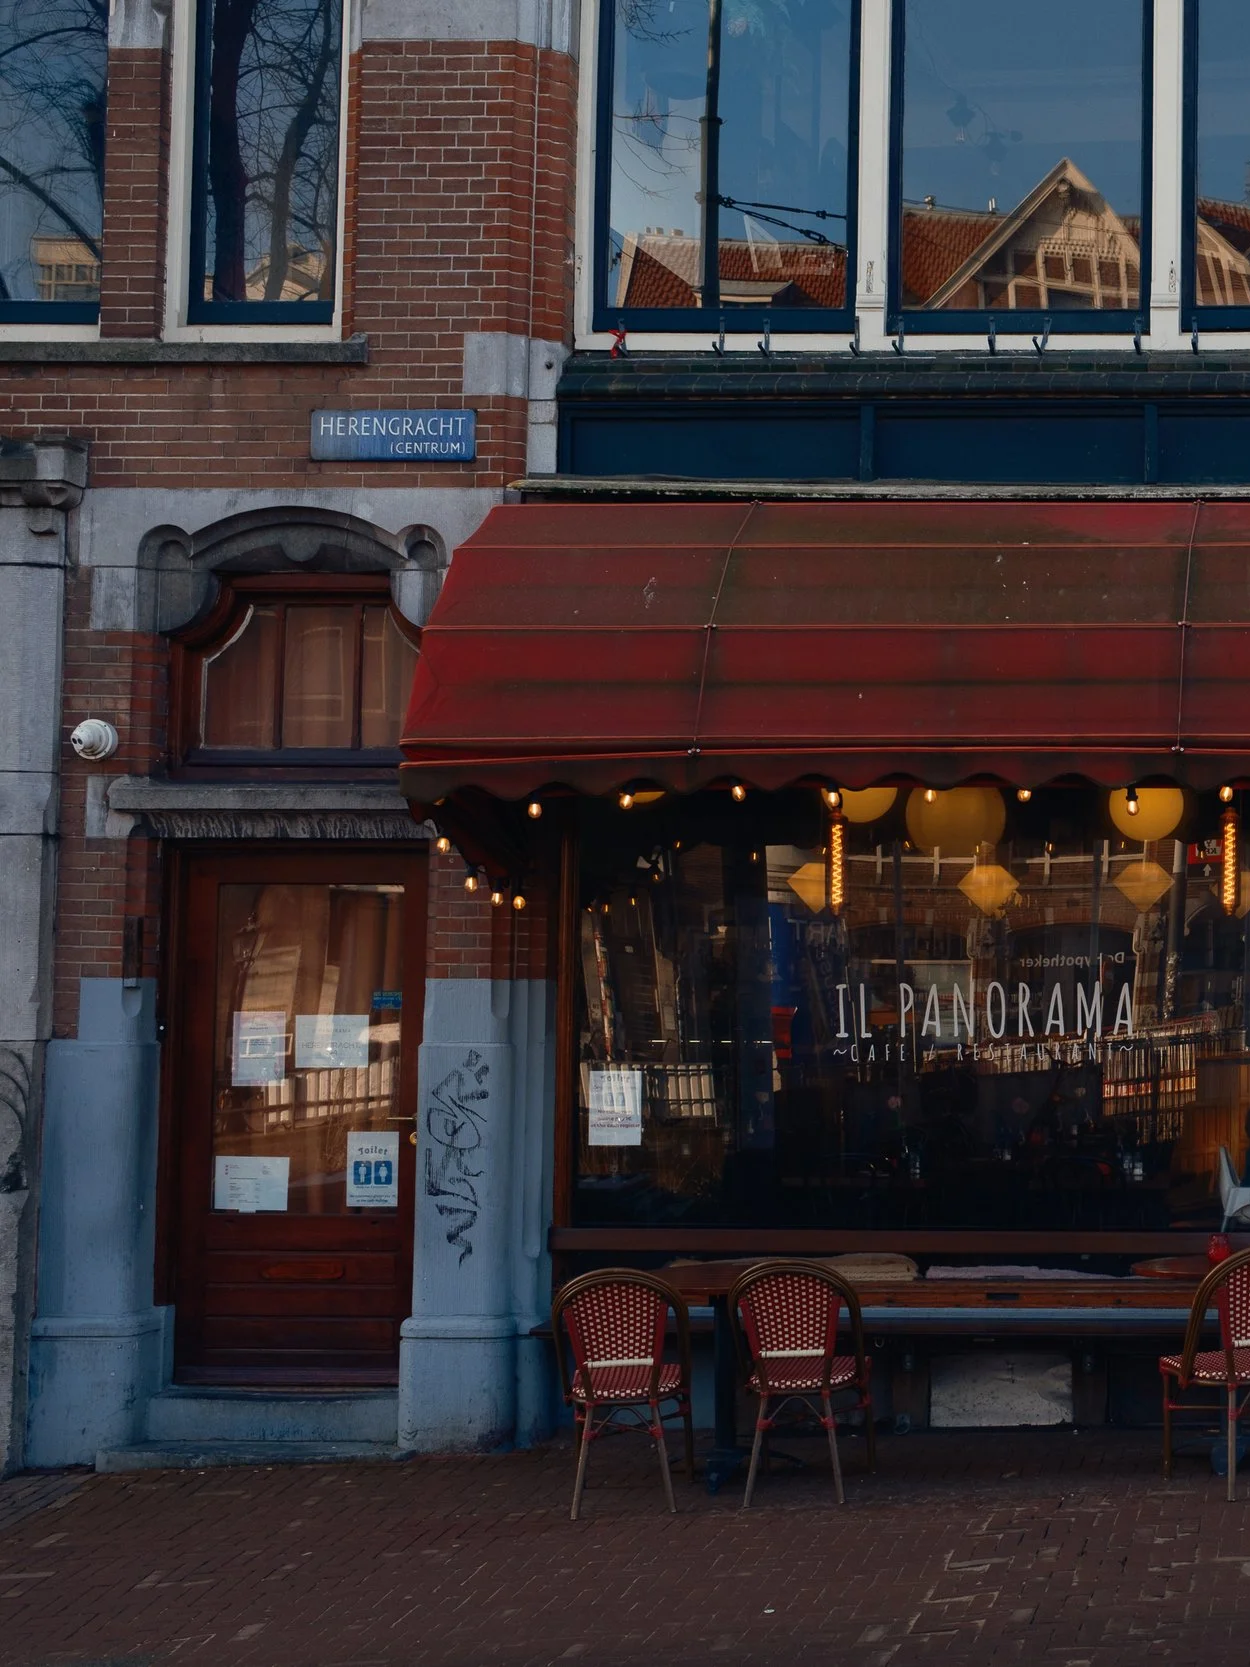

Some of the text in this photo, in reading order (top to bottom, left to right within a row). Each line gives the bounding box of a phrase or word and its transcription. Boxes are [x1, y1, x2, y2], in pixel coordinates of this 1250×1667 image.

[320, 416, 466, 436] HERENGRACHT
[390, 441, 466, 455] (CENTRUM)
[835, 981, 1134, 1039] IL PANORAMA
[358, 1145, 388, 1155] Toilet
